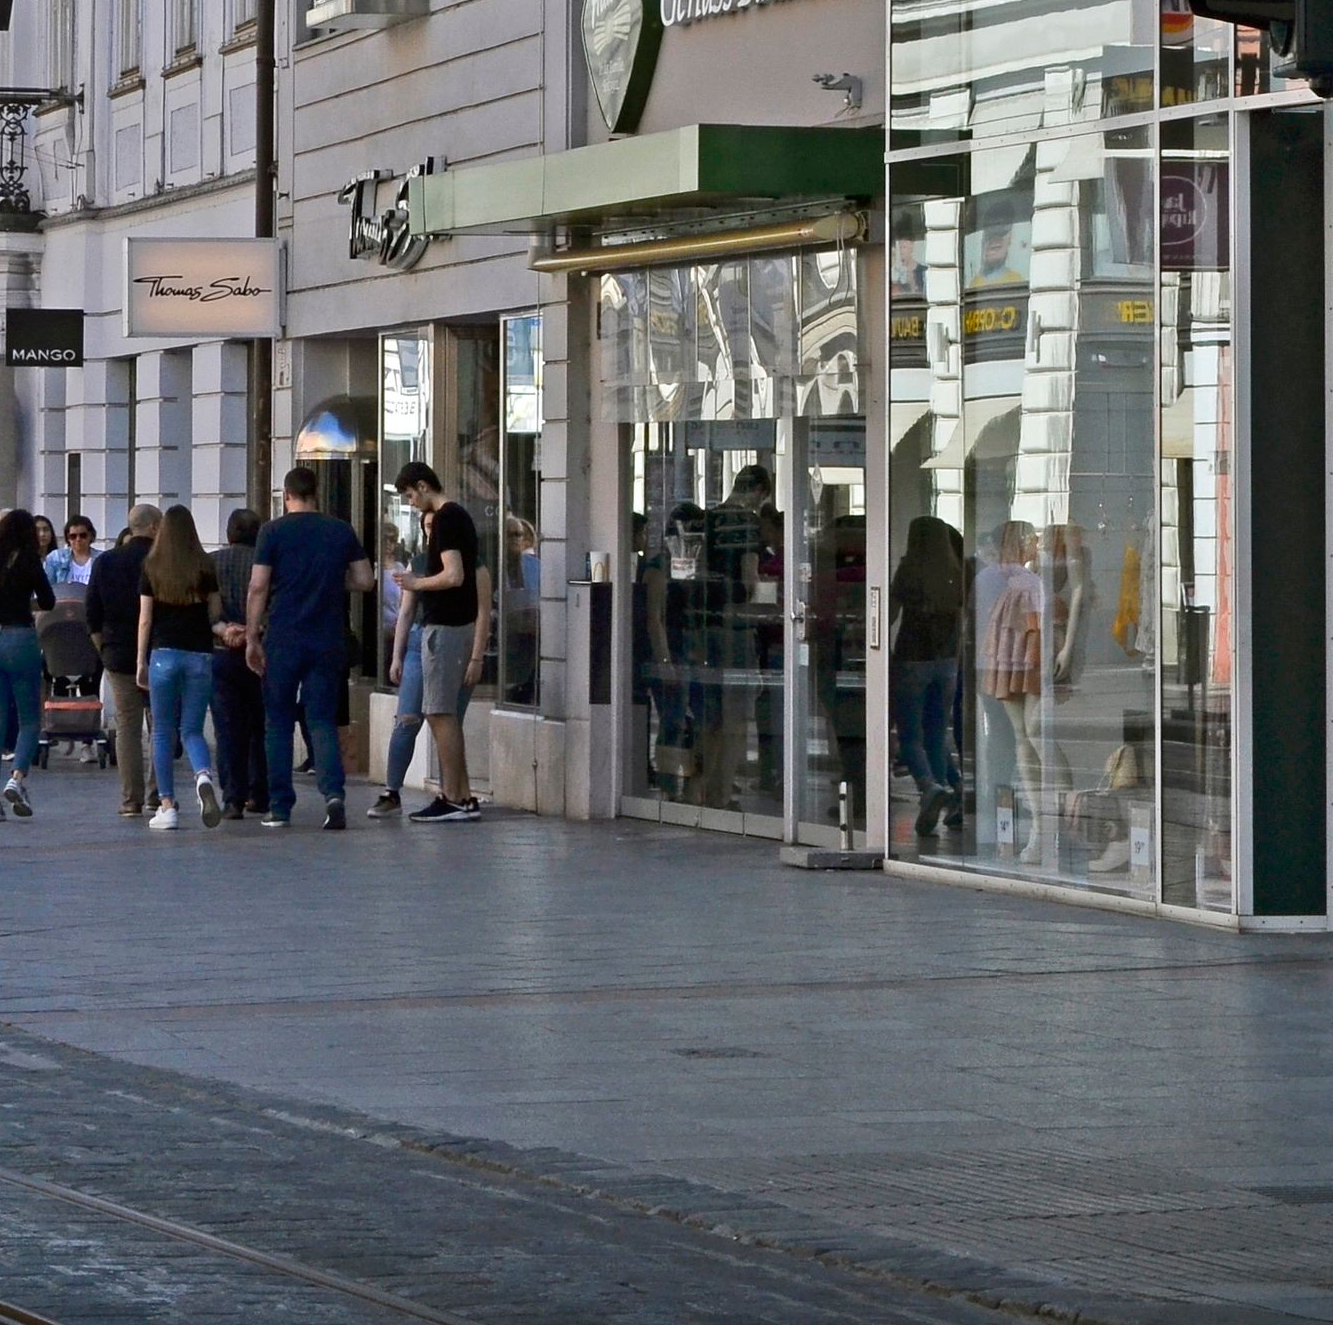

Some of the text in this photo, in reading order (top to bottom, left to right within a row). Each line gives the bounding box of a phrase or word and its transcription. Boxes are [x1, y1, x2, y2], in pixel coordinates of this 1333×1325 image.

[132, 275, 273, 303] Thomas Sabo
[11, 348, 76, 362] MANGO
